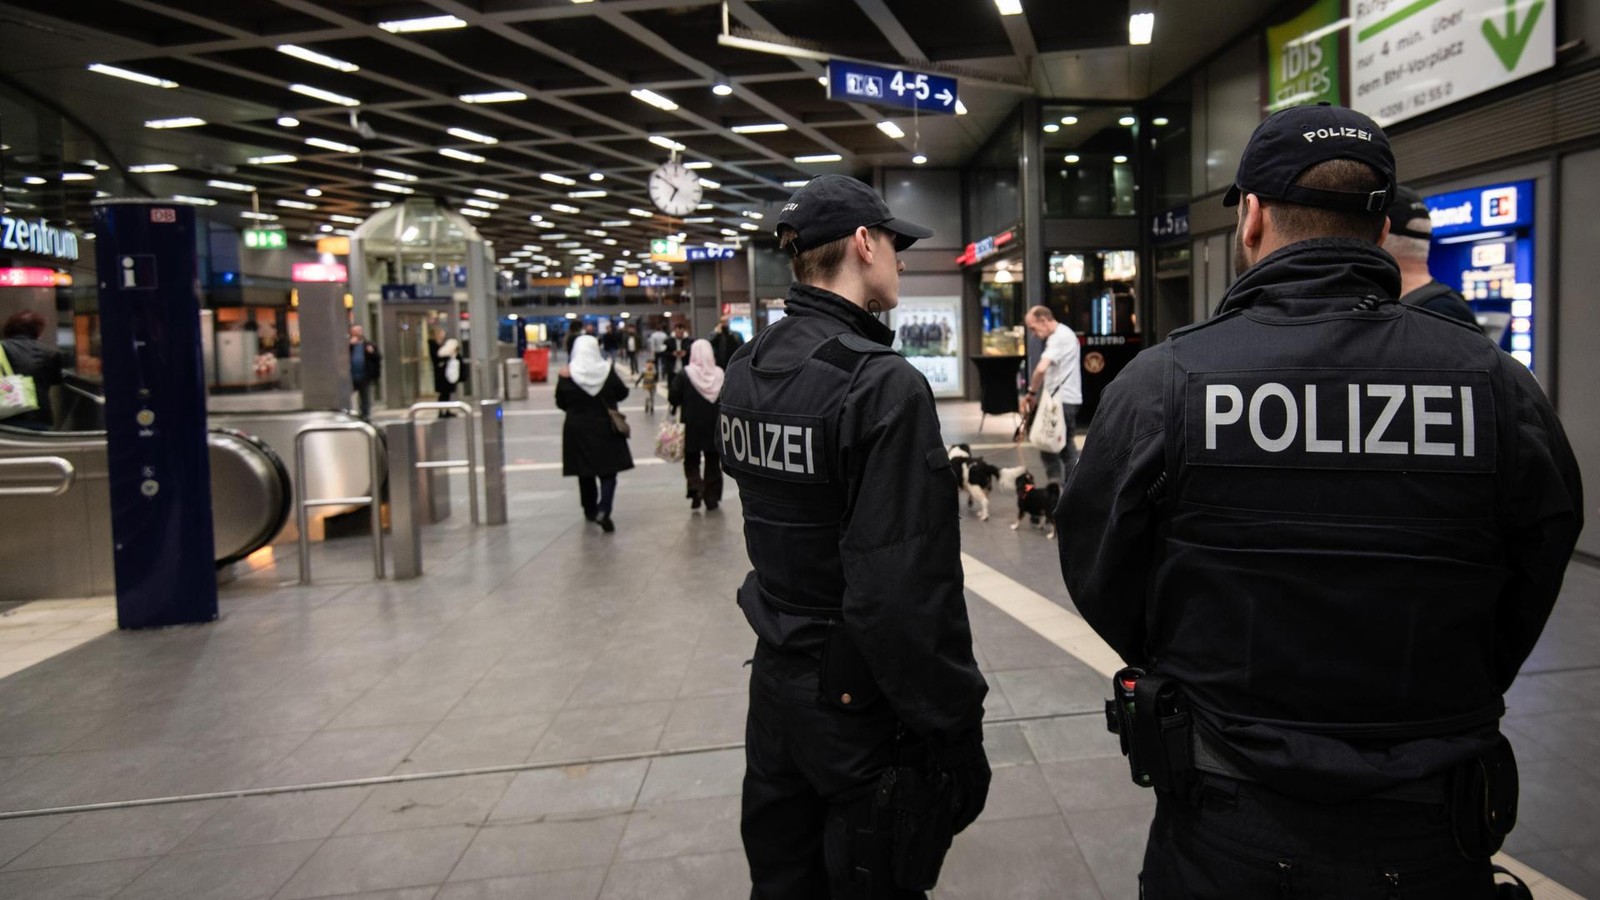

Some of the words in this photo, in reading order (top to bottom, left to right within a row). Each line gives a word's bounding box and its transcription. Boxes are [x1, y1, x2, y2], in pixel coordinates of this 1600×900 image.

[1381, 41, 1390, 56] 4
[890, 71, 930, 100] 4-5
[1357, 77, 1381, 97] dem
[1303, 126, 1372, 143] POLIZEI
[151, 209, 176, 222] DB
[0, 216, 79, 260] zentrum
[1087, 336, 1126, 346] BISTRO
[1206, 382, 1475, 457] POLIZEI
[720, 413, 815, 474] POLIZEI
